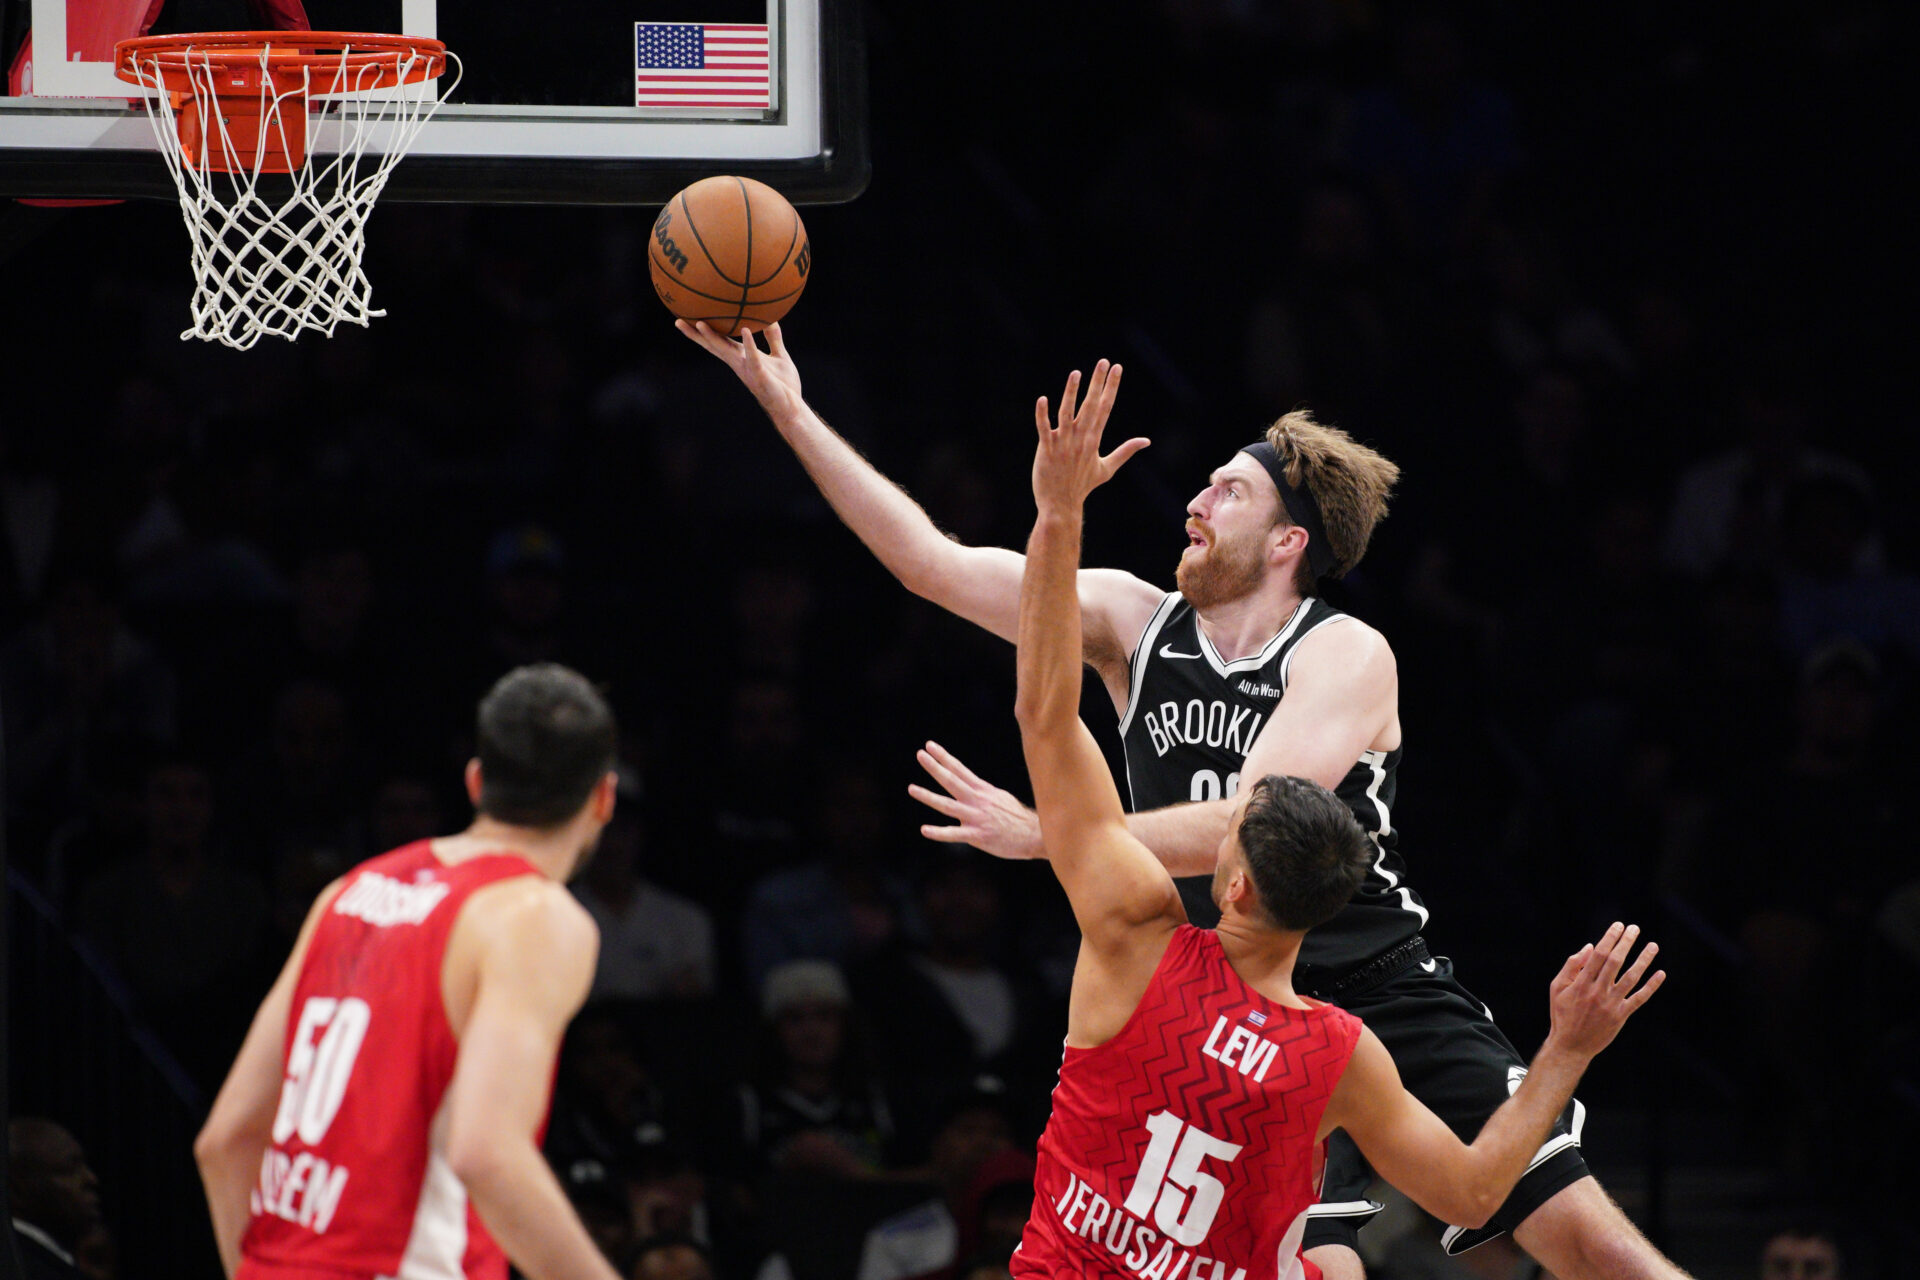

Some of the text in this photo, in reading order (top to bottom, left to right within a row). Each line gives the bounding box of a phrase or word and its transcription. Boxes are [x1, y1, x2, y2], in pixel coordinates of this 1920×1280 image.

[1238, 678, 1252, 695] All
[1260, 683, 1280, 698] Won
[1144, 699, 1262, 758] BROOKL
[273, 996, 371, 1146] 50
[1202, 1014, 1280, 1084] LEVI
[1123, 1109, 1244, 1247] 15
